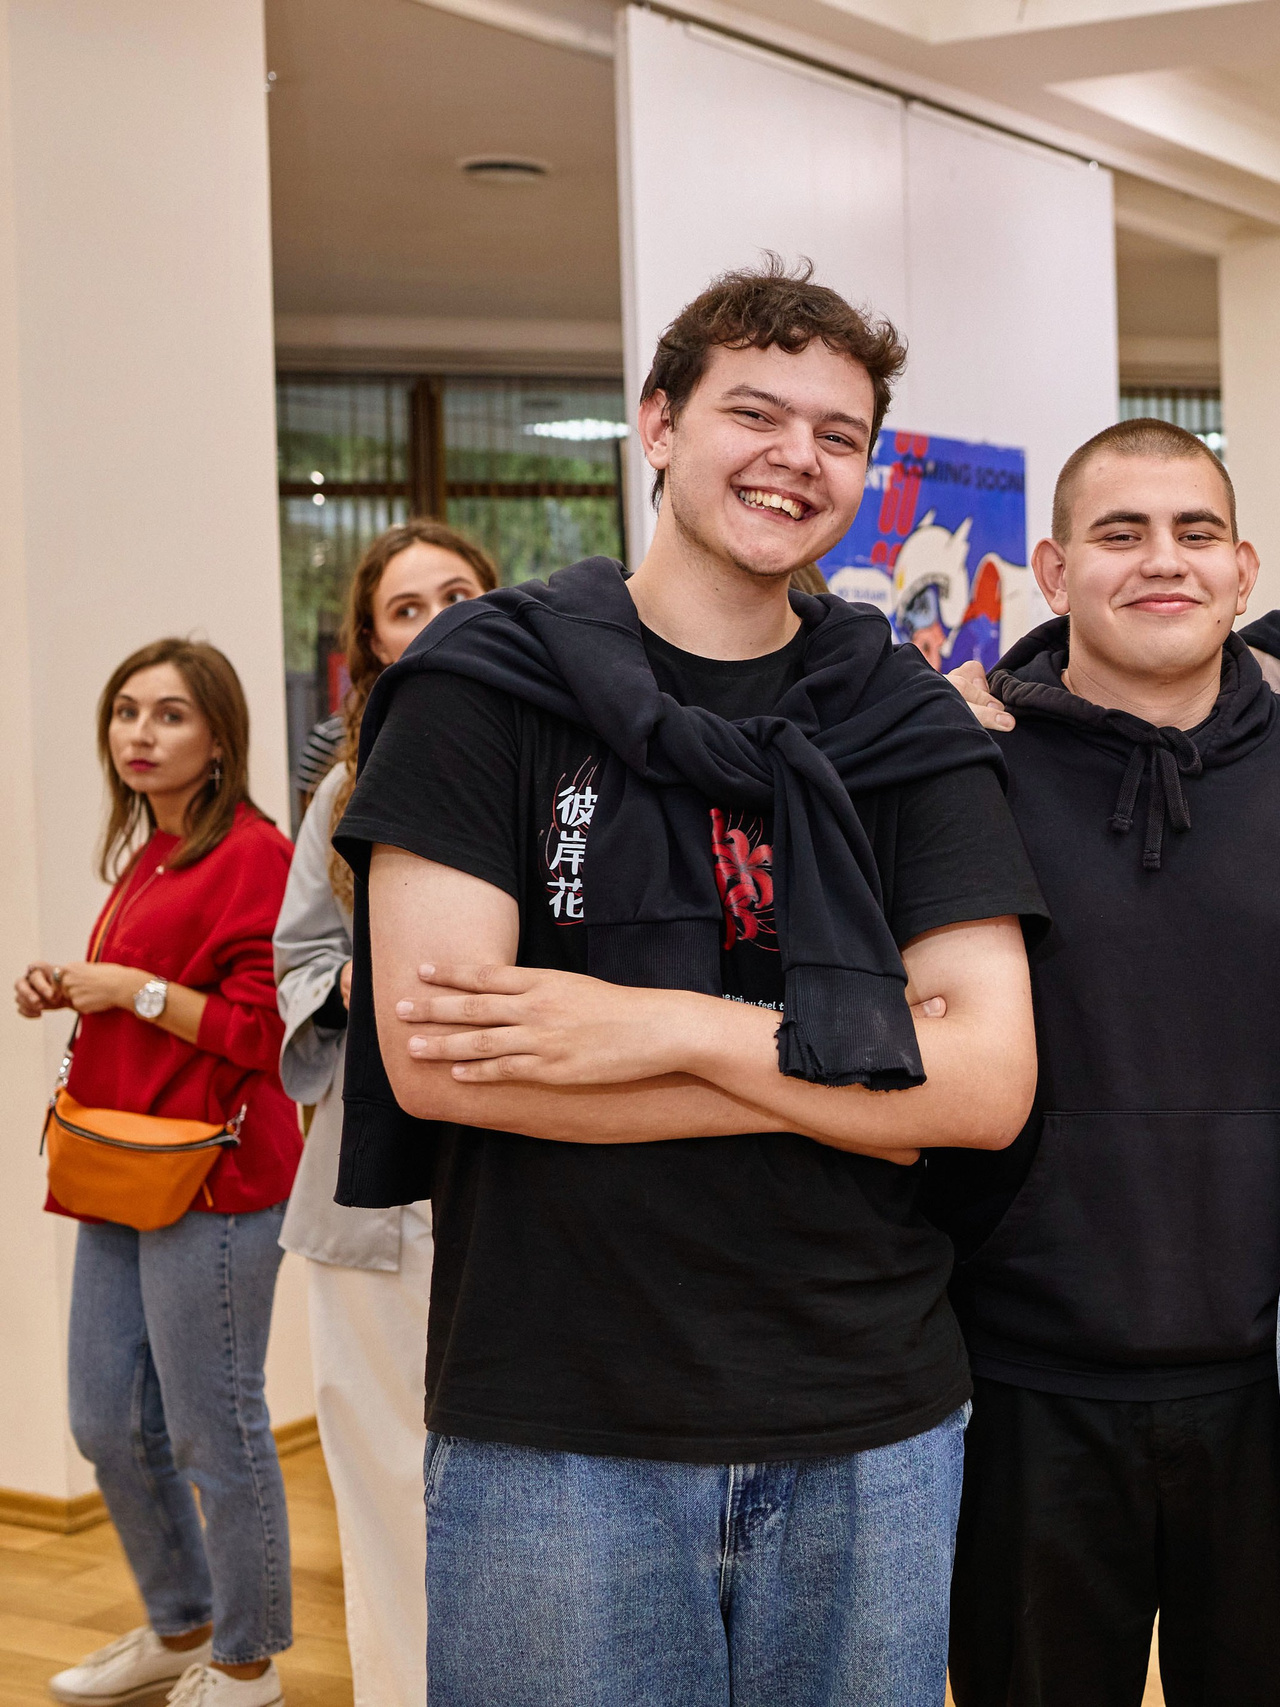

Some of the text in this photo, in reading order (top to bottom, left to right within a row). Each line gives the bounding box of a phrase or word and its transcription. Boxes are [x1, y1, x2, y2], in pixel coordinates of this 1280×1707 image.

[547, 785, 599, 919] 彼岸花
[757, 1000, 777, 1010] feel
